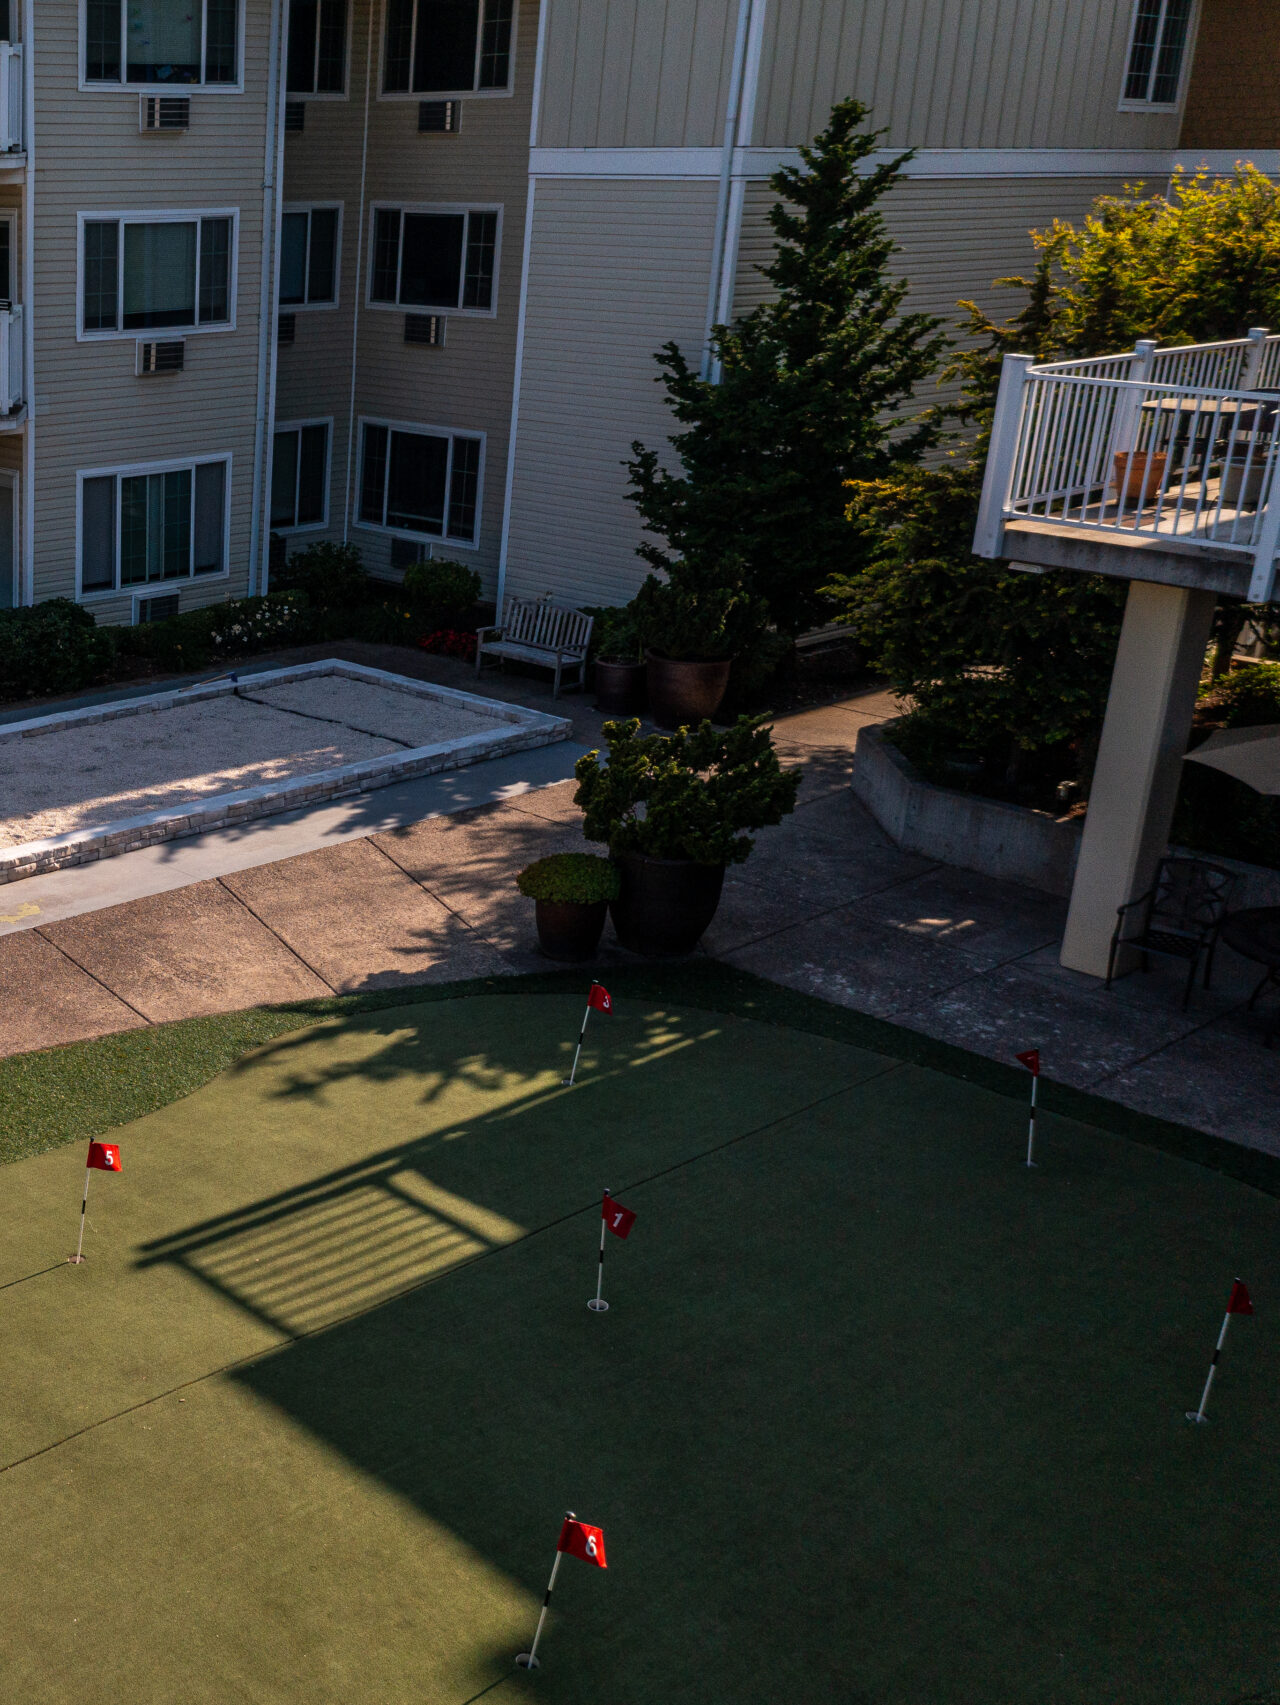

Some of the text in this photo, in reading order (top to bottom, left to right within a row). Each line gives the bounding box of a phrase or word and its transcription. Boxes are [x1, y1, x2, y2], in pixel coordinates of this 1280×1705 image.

[603, 995, 610, 1008] 3
[105, 1150, 114, 1166] 5
[585, 1535, 597, 1556] 6
